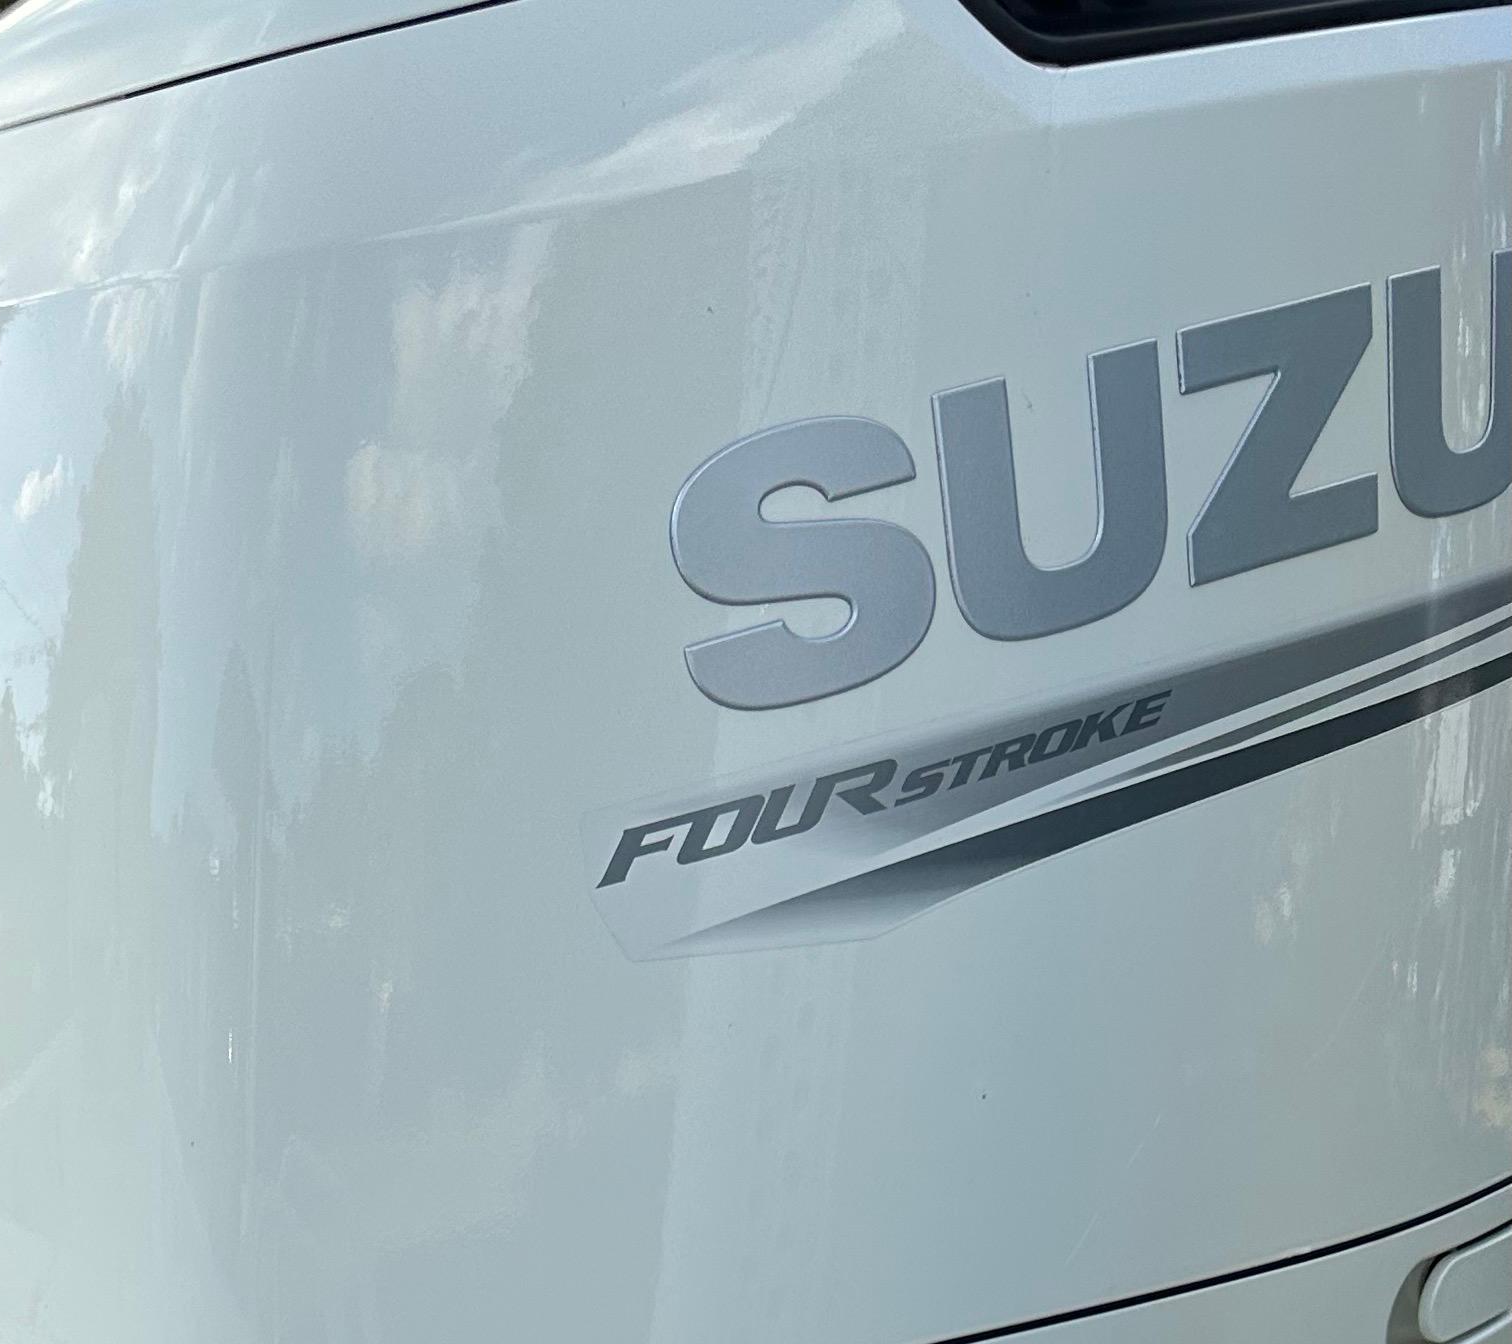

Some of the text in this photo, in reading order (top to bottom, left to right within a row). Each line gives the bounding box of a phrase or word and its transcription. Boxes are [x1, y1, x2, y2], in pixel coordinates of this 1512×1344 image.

[669, 250, 1512, 712] SUZU
[595, 689, 1173, 889] FOUR STROKE
